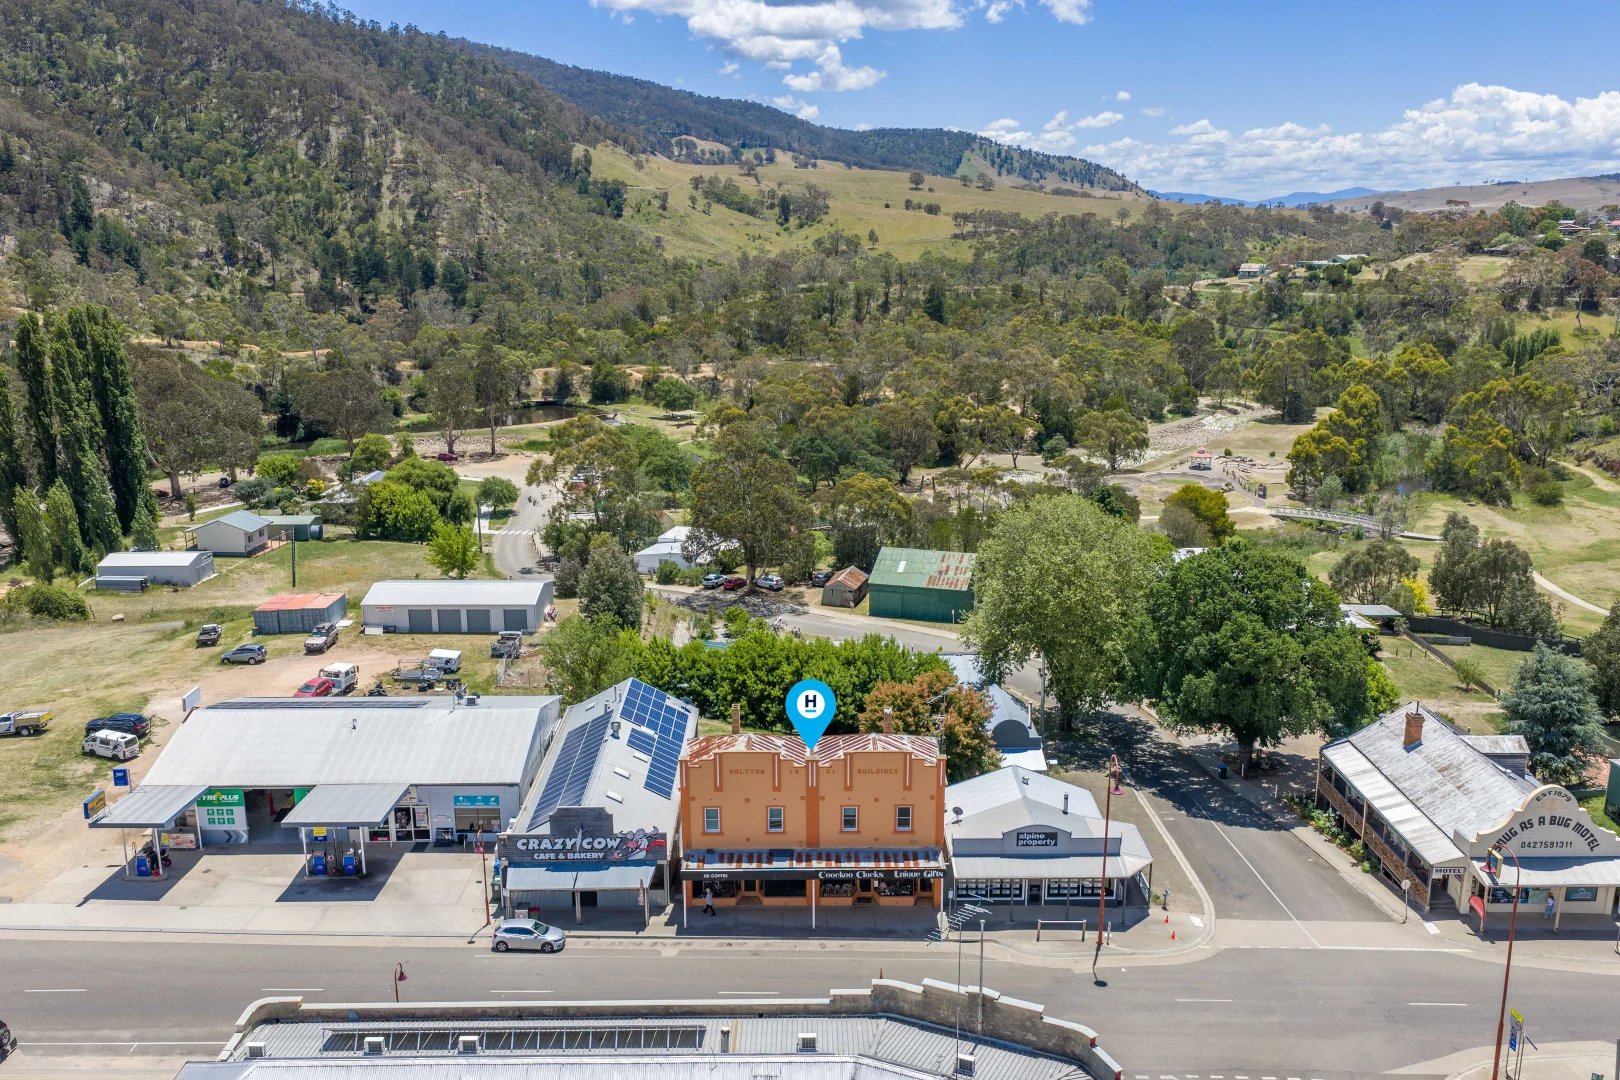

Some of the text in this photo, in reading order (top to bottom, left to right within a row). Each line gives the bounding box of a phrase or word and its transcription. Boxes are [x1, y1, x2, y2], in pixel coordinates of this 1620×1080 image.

[1018, 832, 1045, 841] alpine
[1519, 818, 1534, 832] AS
[1538, 815, 1546, 827] A
[1549, 815, 1573, 828] BUG
[1572, 822, 1601, 852] MOTEL
[516, 837, 621, 851] CRAZY COW
[1018, 838, 1056, 847] property
[1520, 841, 1573, 849] 0427591311
[533, 852, 605, 860] CAFE & BAKERY
[855, 870, 885, 879] Clocks
[893, 870, 921, 879] Unique
[923, 869, 944, 879] Gifts
